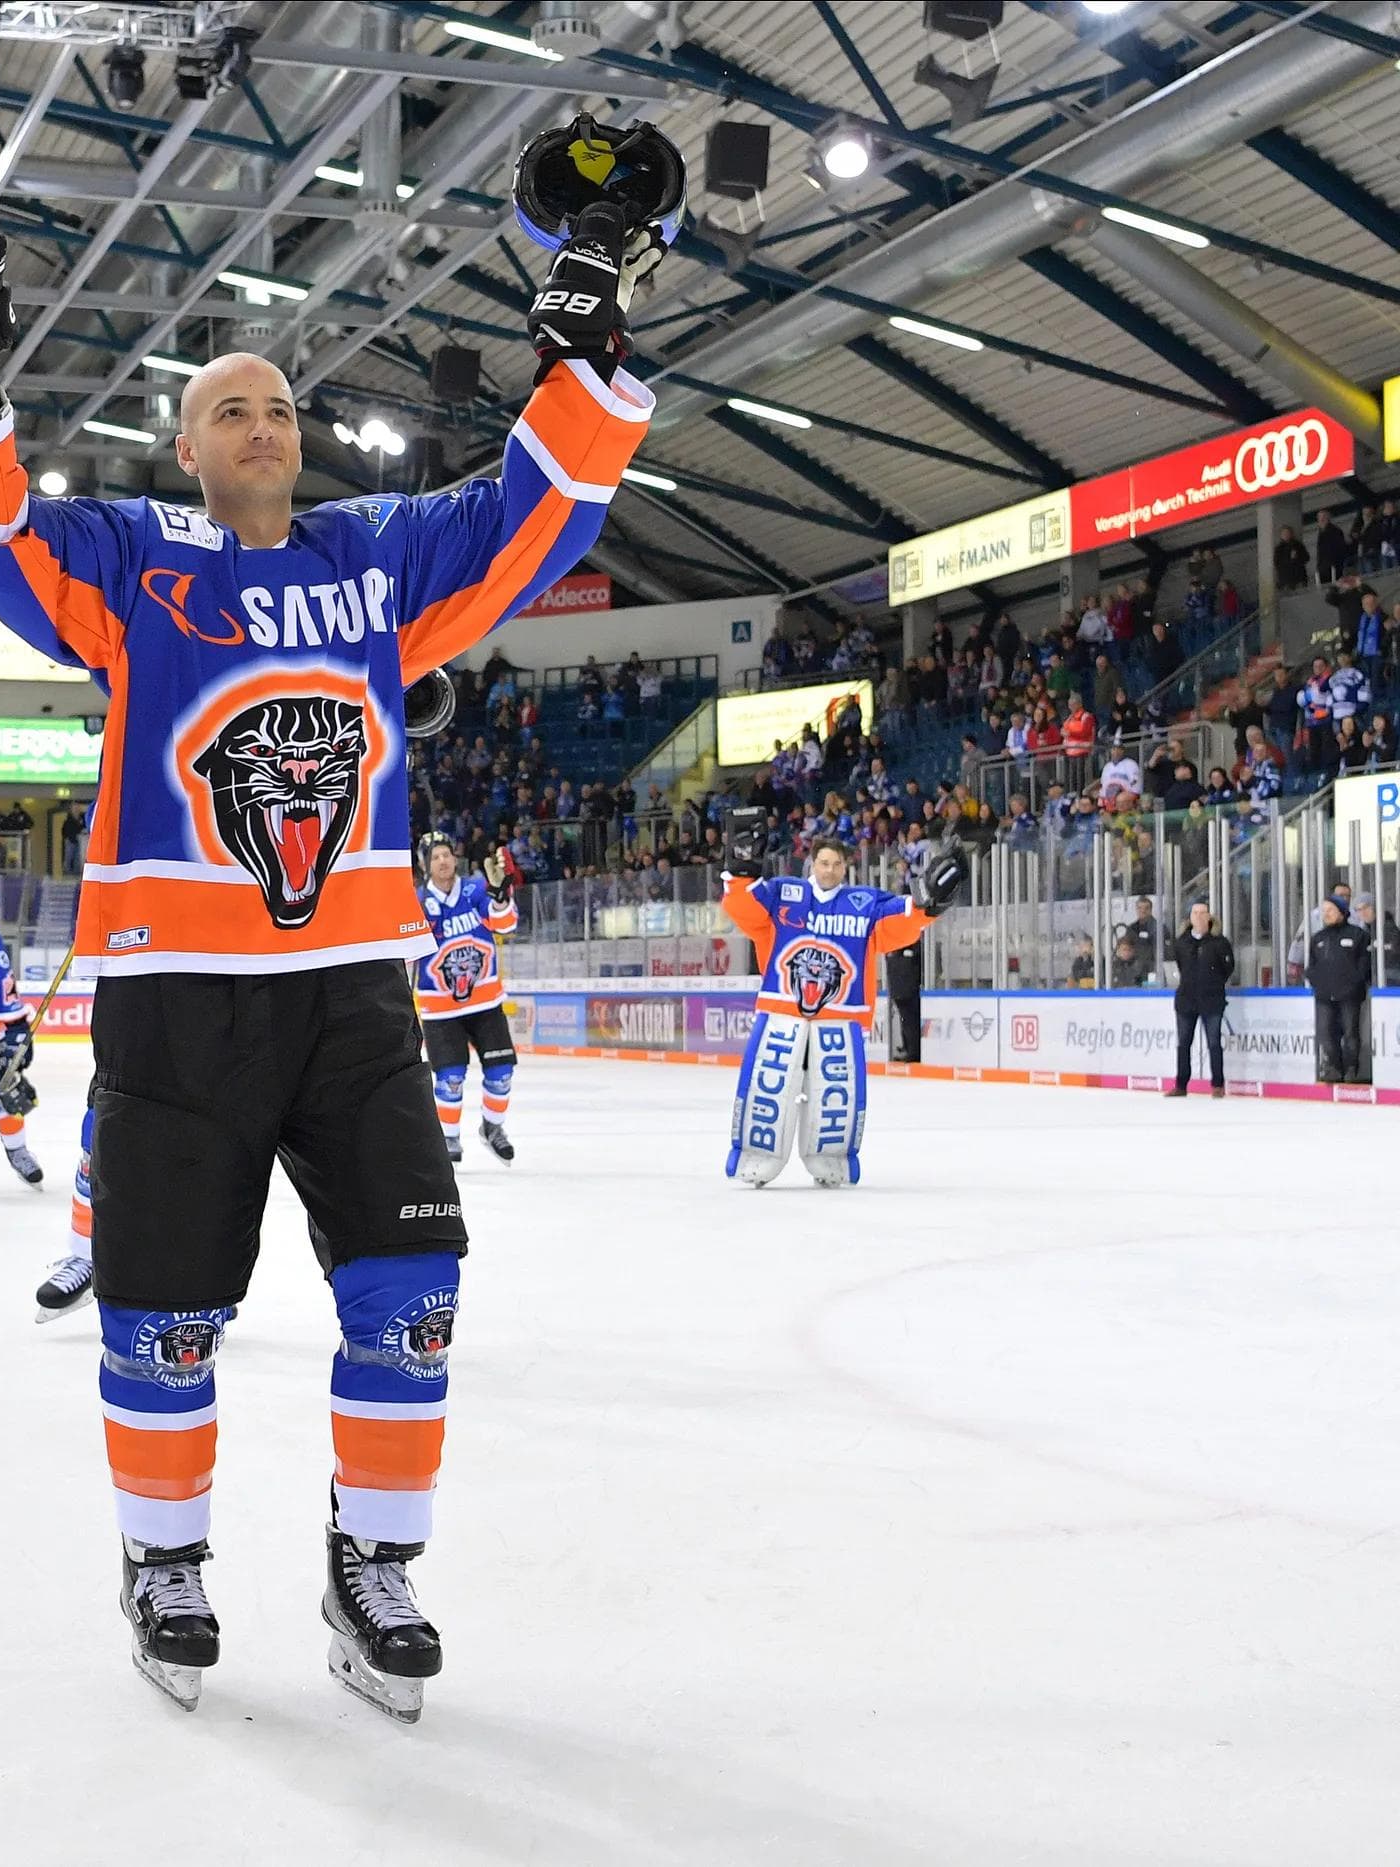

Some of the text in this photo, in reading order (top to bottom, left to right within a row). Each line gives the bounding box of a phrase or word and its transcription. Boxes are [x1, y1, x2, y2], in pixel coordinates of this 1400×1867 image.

[1201, 459, 1233, 483] Audi
[1095, 479, 1233, 533] Vorsprung durch Technik
[541, 584, 610, 609] Adecco
[734, 623, 749, 641] A
[806, 911, 871, 938] SATURN
[619, 1003, 675, 1043] SATURN
[1014, 1021, 1036, 1045] DB
[1065, 1020, 1115, 1055] Regio
[750, 1023, 799, 1153] BÜCHL
[816, 1026, 849, 1153] BÜCHL
[422, 1292, 452, 1311] Die
